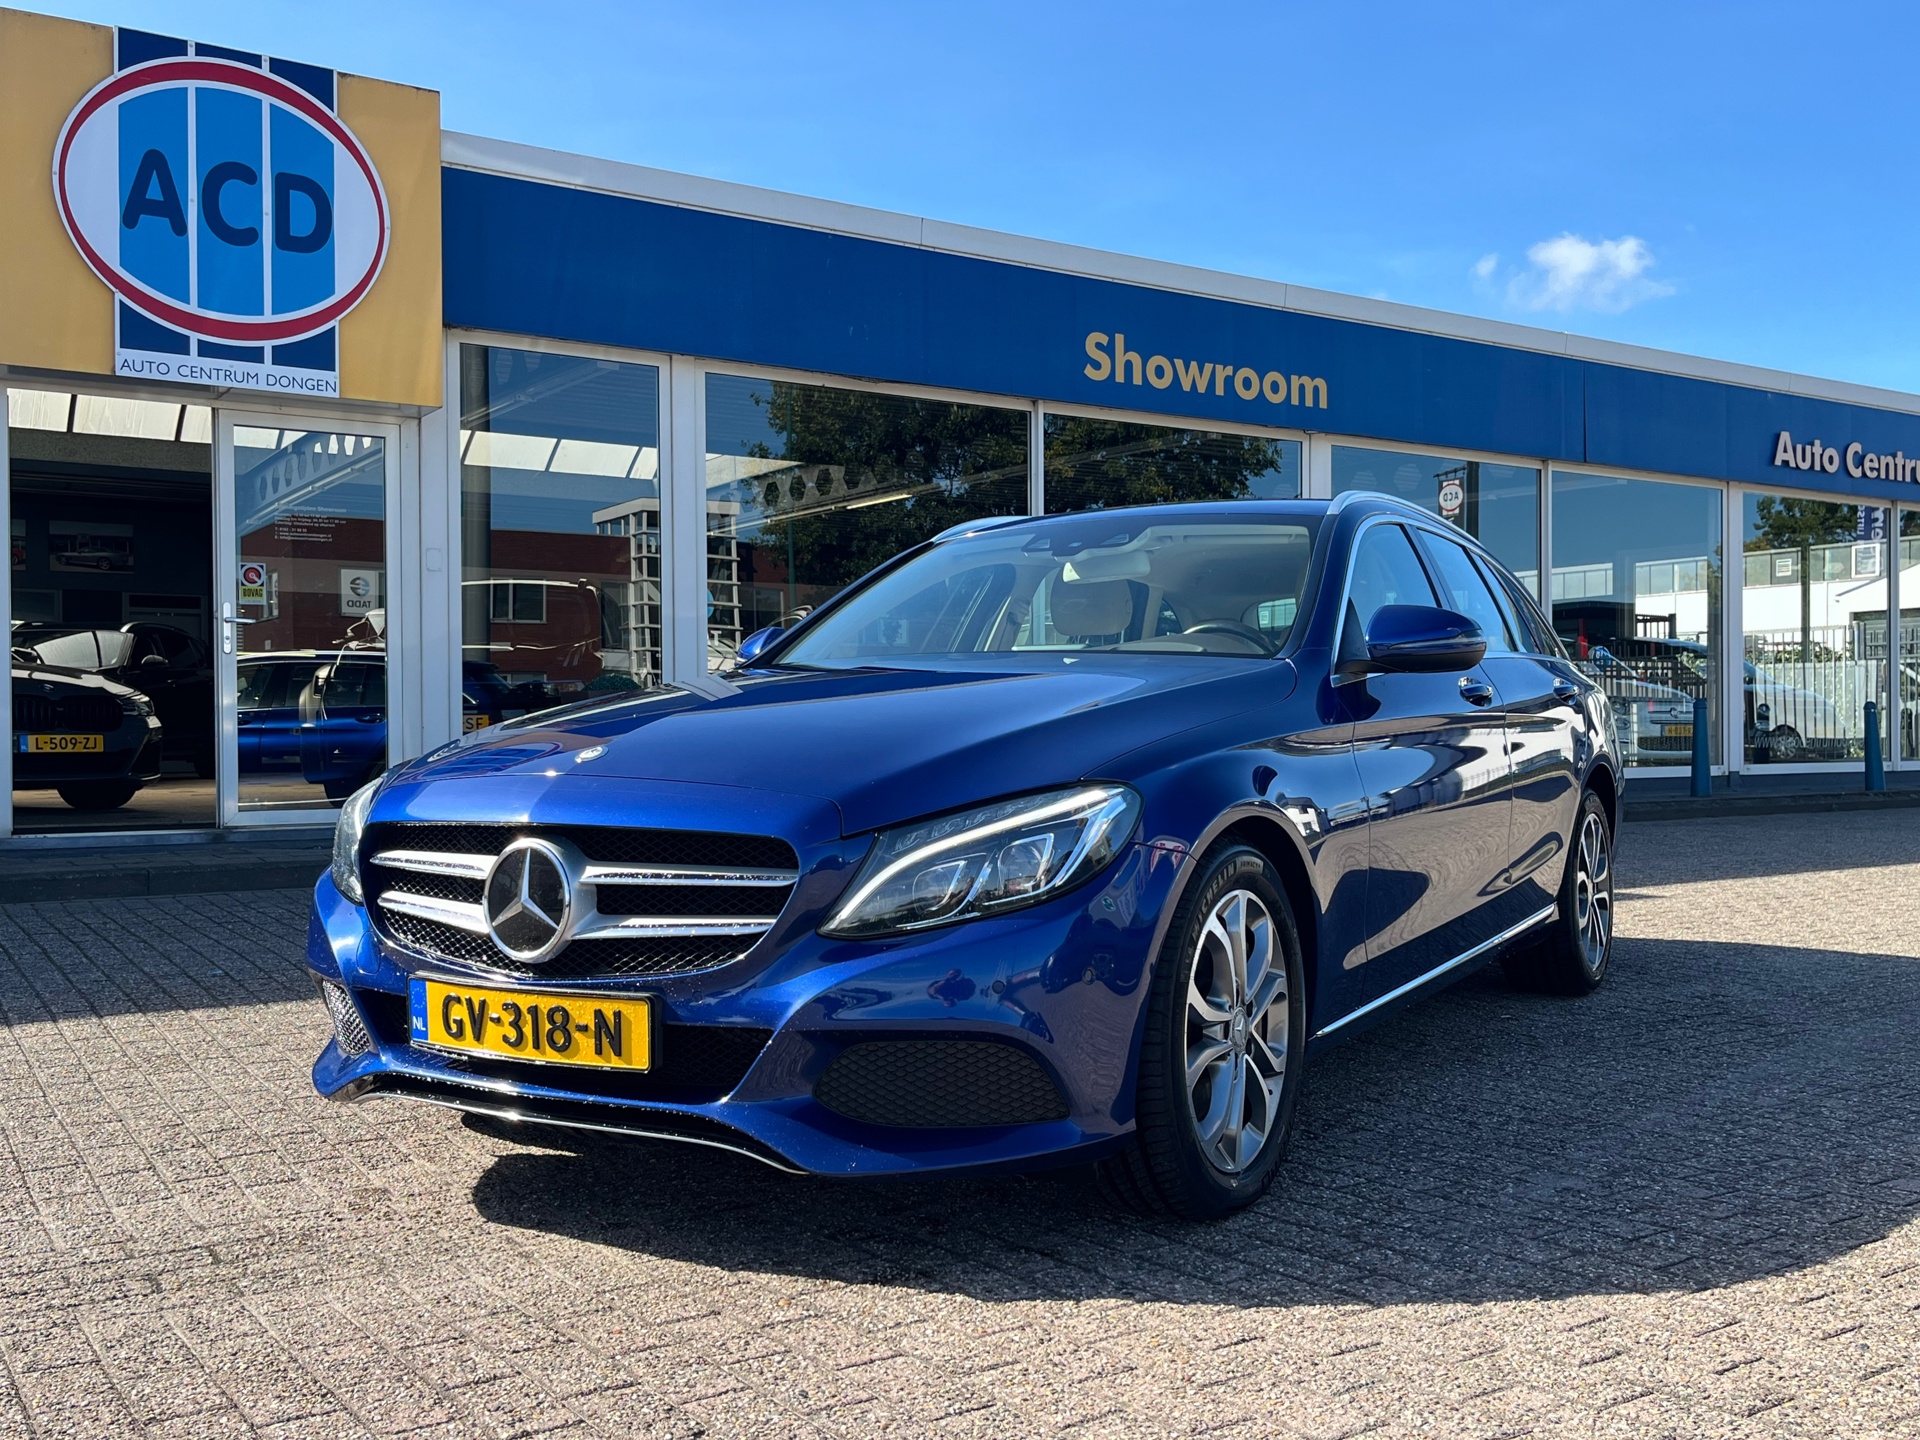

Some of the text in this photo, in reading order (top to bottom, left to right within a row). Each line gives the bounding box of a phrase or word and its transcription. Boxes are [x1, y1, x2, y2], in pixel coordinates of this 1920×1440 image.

[122, 149, 333, 254] ACD
[120, 358, 337, 393] AUTO CENTRUM DONGEN
[1084, 331, 1328, 410] Showroom
[1774, 430, 1920, 485] Auto Centr
[242, 588, 263, 598] BOVAG
[35, 737, 97, 750] L-509-ZJ
[413, 1015, 426, 1031] NL
[441, 992, 622, 1057] GV-318-N
